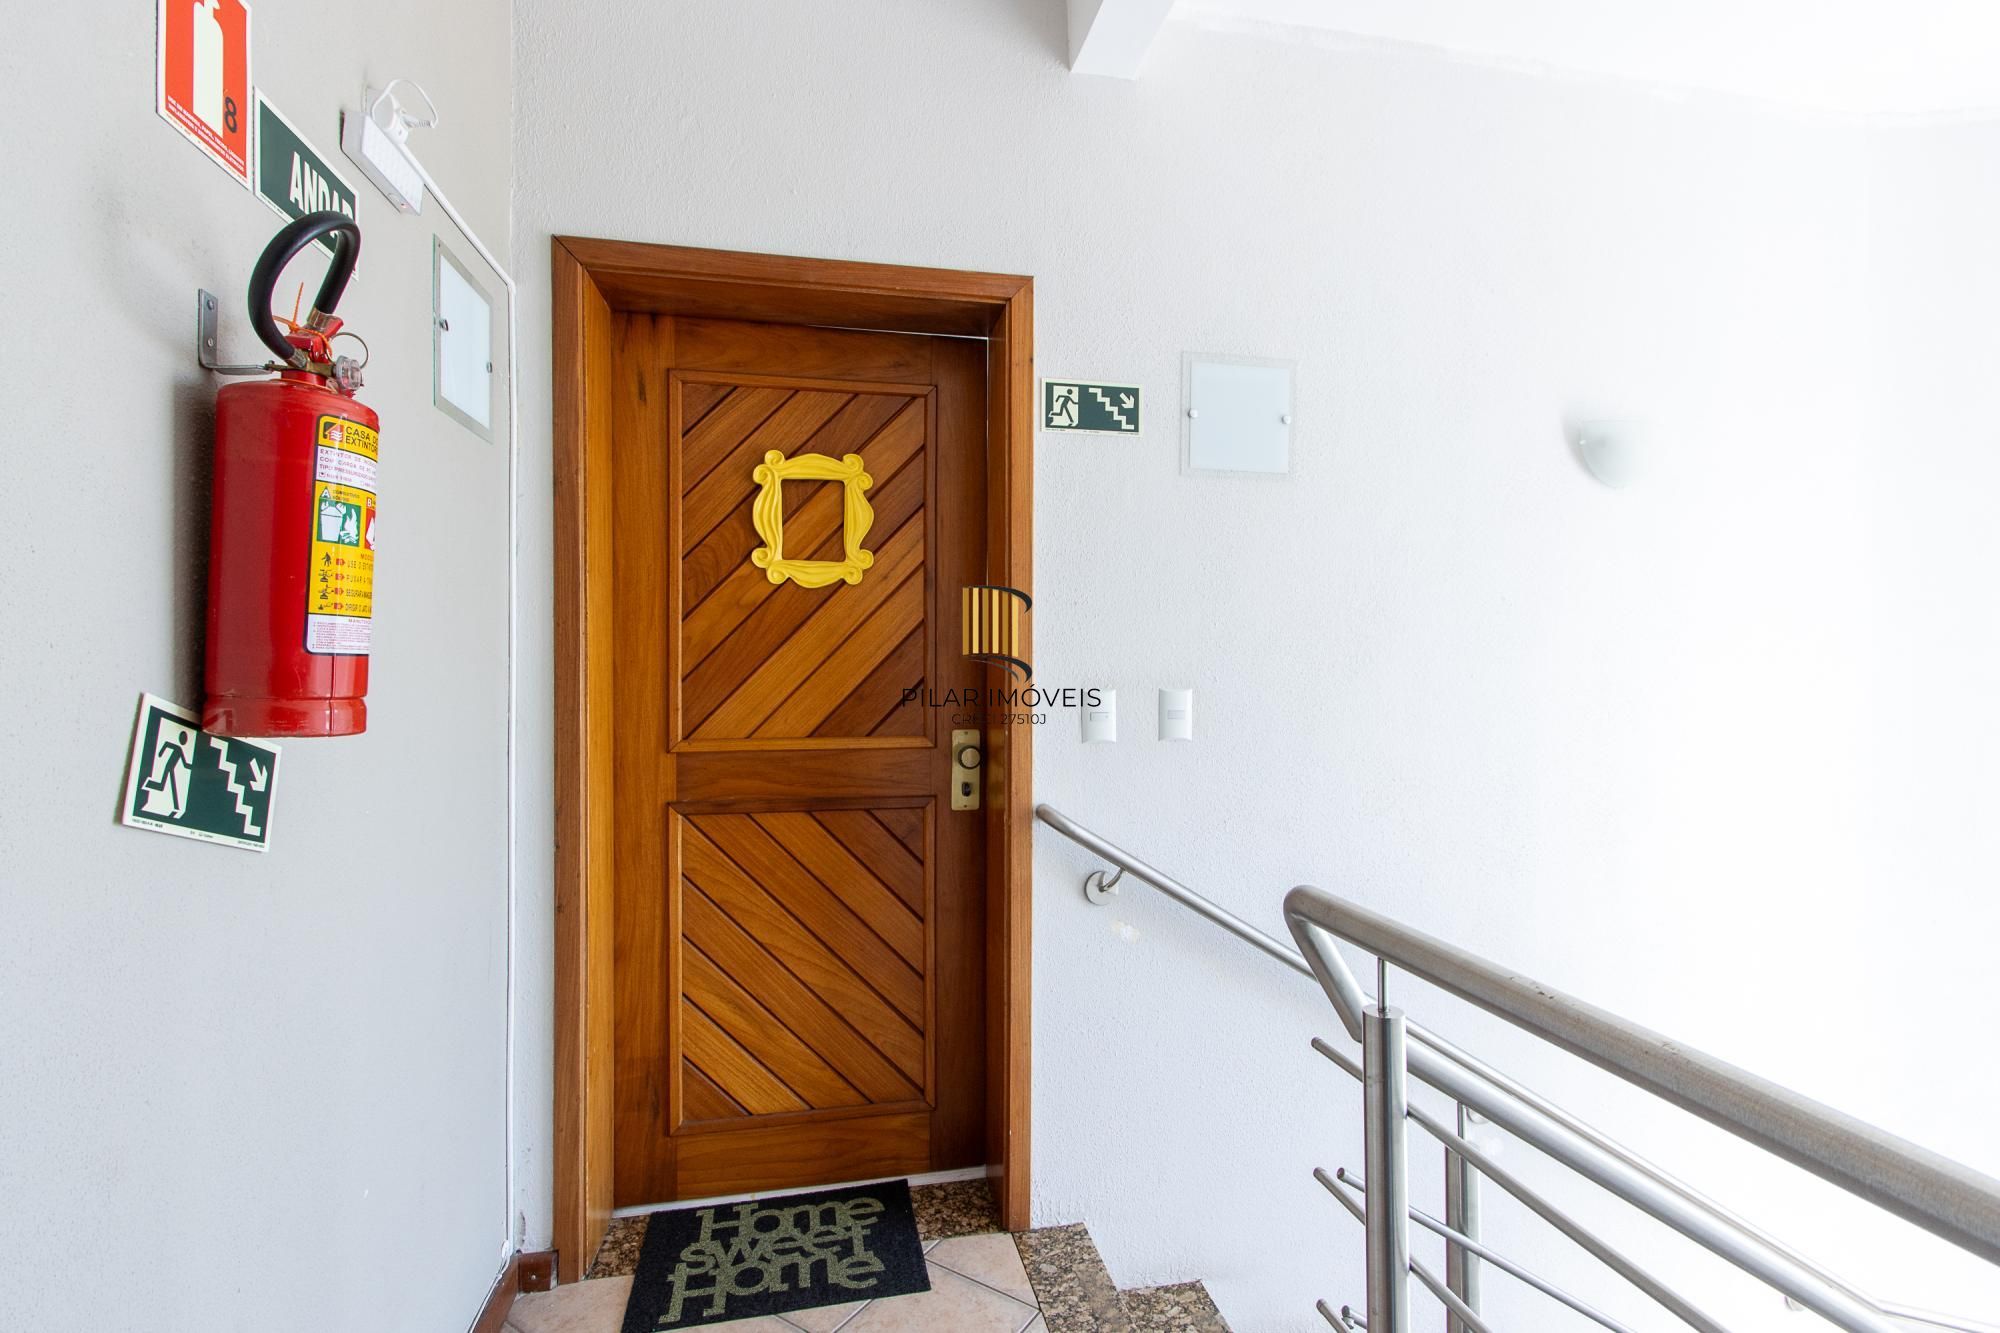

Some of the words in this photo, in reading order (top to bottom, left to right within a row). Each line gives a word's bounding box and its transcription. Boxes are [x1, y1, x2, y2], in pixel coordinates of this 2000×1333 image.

[224, 97, 237, 133] 8
[346, 426, 370, 441] CASA
[695, 1196, 886, 1246] Home
[679, 1221, 875, 1275] sweet
[658, 1252, 886, 1324] Home
